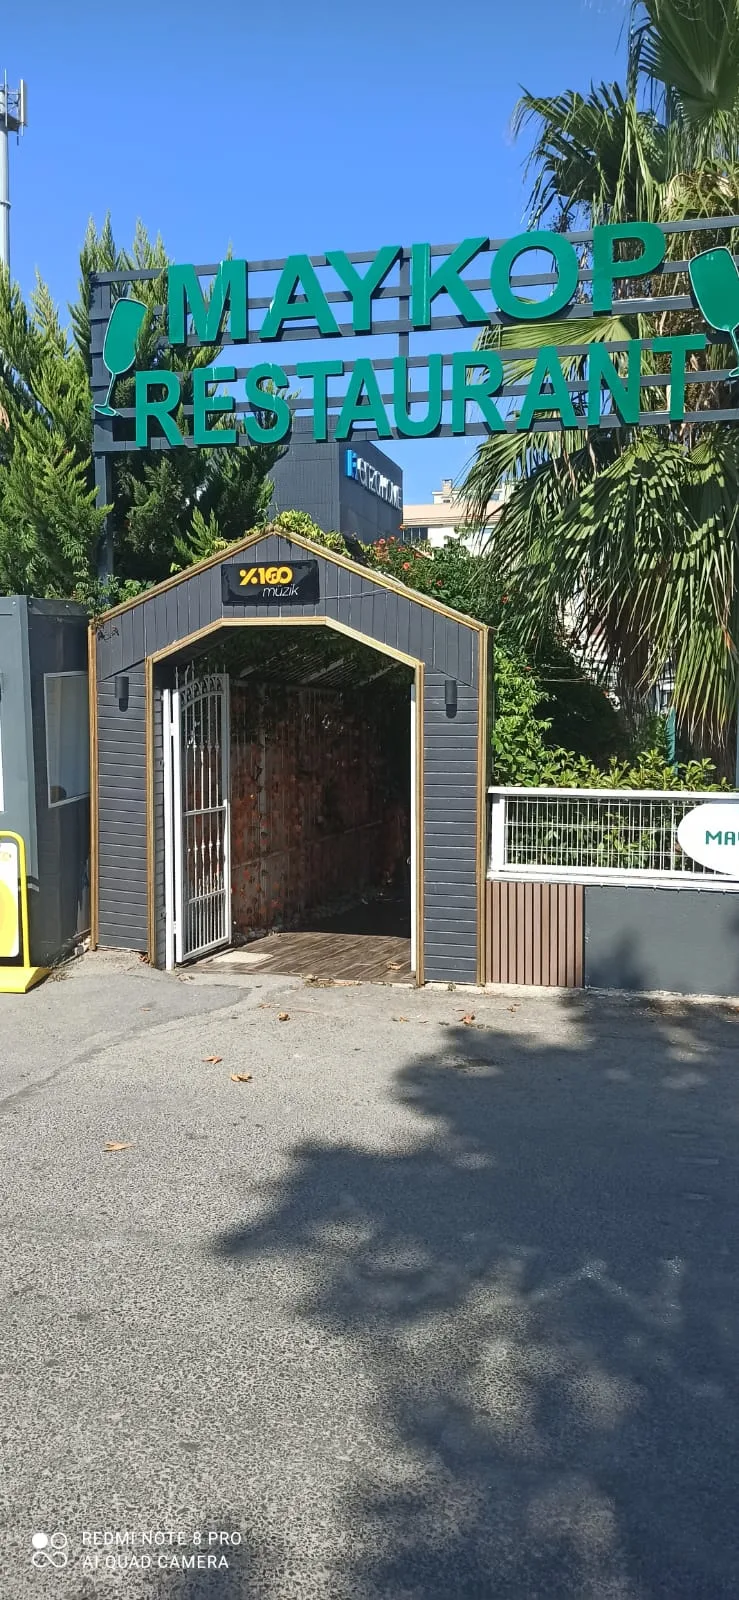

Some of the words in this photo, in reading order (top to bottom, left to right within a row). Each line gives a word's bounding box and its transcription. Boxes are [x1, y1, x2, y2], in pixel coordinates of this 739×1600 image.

[167, 222, 666, 346] MAYKOP
[134, 333, 706, 449] RESTAURANT
[262, 583, 299, 598] müzik
[705, 830, 739, 846] MA
